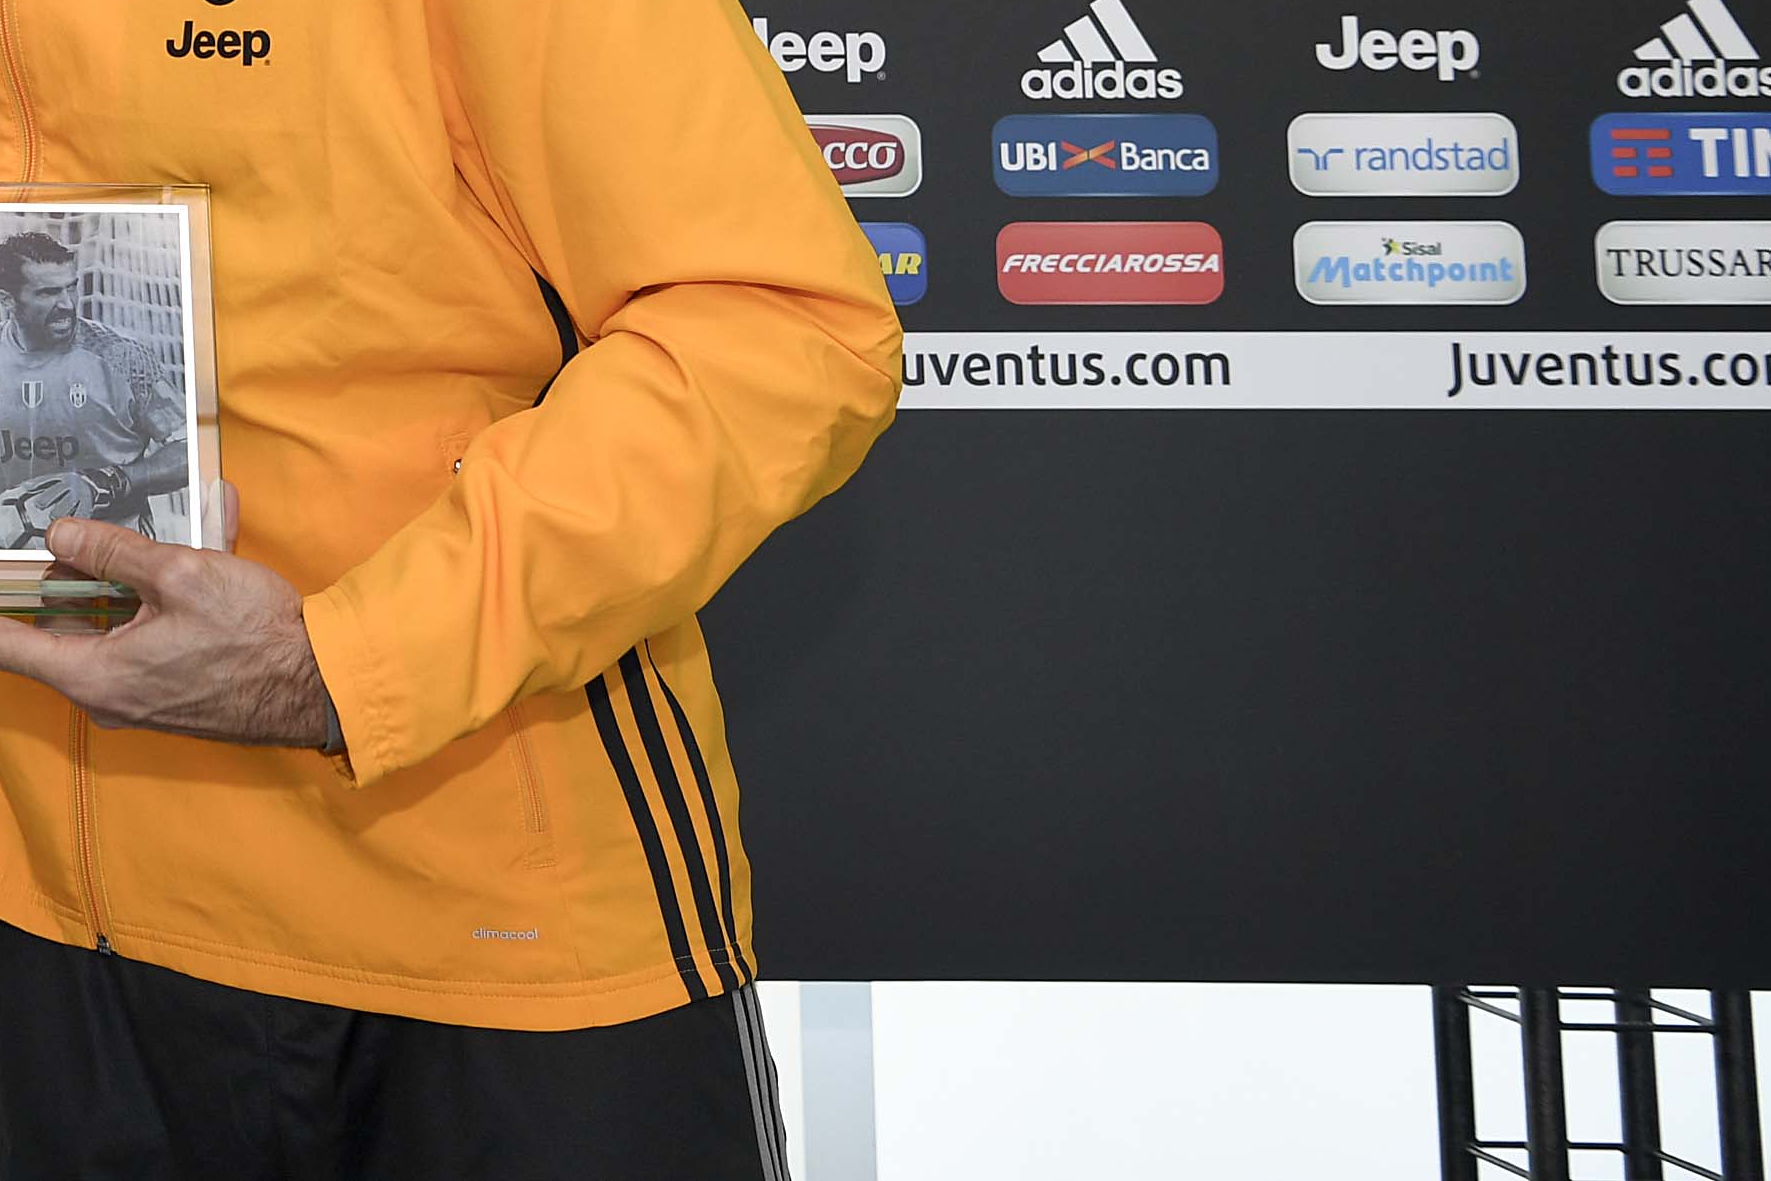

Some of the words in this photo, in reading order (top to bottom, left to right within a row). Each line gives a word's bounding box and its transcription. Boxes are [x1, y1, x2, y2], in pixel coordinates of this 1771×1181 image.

[165, 20, 271, 67] Jeep
[1314, 15, 1481, 82] Jeep
[1020, 59, 1184, 100] adidas
[999, 141, 1058, 171] UBI
[1119, 141, 1211, 171] Banca
[1354, 137, 1510, 172] randstad
[1002, 253, 1220, 274] FRECCIAROSSA
[1401, 241, 1442, 256] Sisal
[1307, 255, 1515, 289] Matchpoint
[902, 345, 1231, 388] uventus.com
[1447, 342, 1771, 398] Juventus.co
[0, 429, 78, 468] Jeep
[472, 927, 539, 940] climacool
